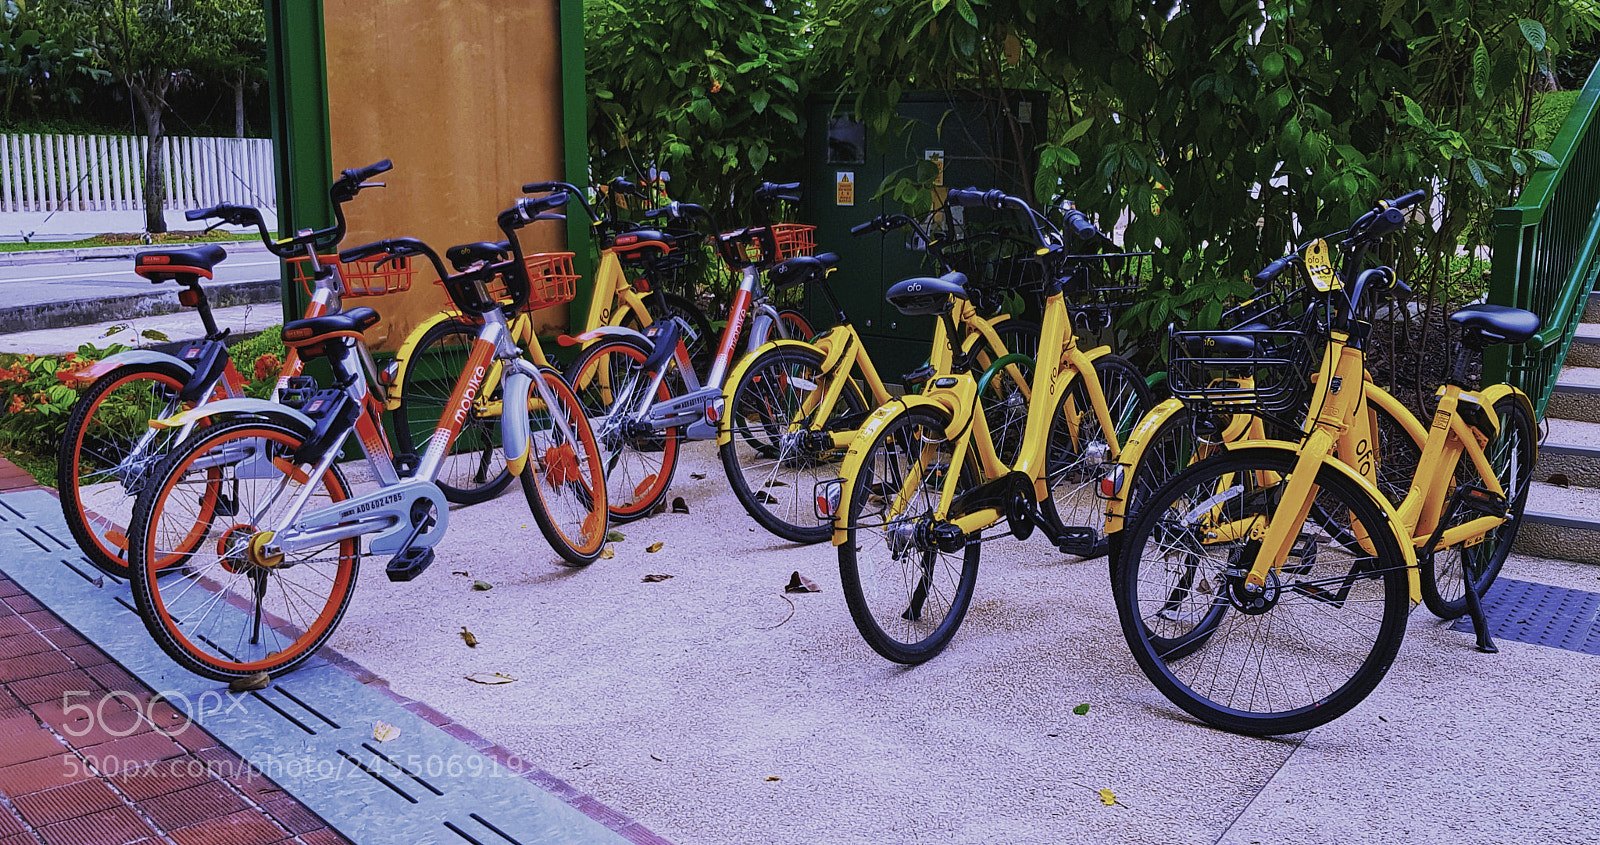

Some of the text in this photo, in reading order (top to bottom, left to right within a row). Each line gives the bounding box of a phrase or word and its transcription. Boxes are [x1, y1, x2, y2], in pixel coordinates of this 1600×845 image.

[907, 282, 921, 292] ofo
[600, 308, 609, 327] fo
[454, 366, 485, 425] mobike
[1356, 439, 1373, 477] ofo
